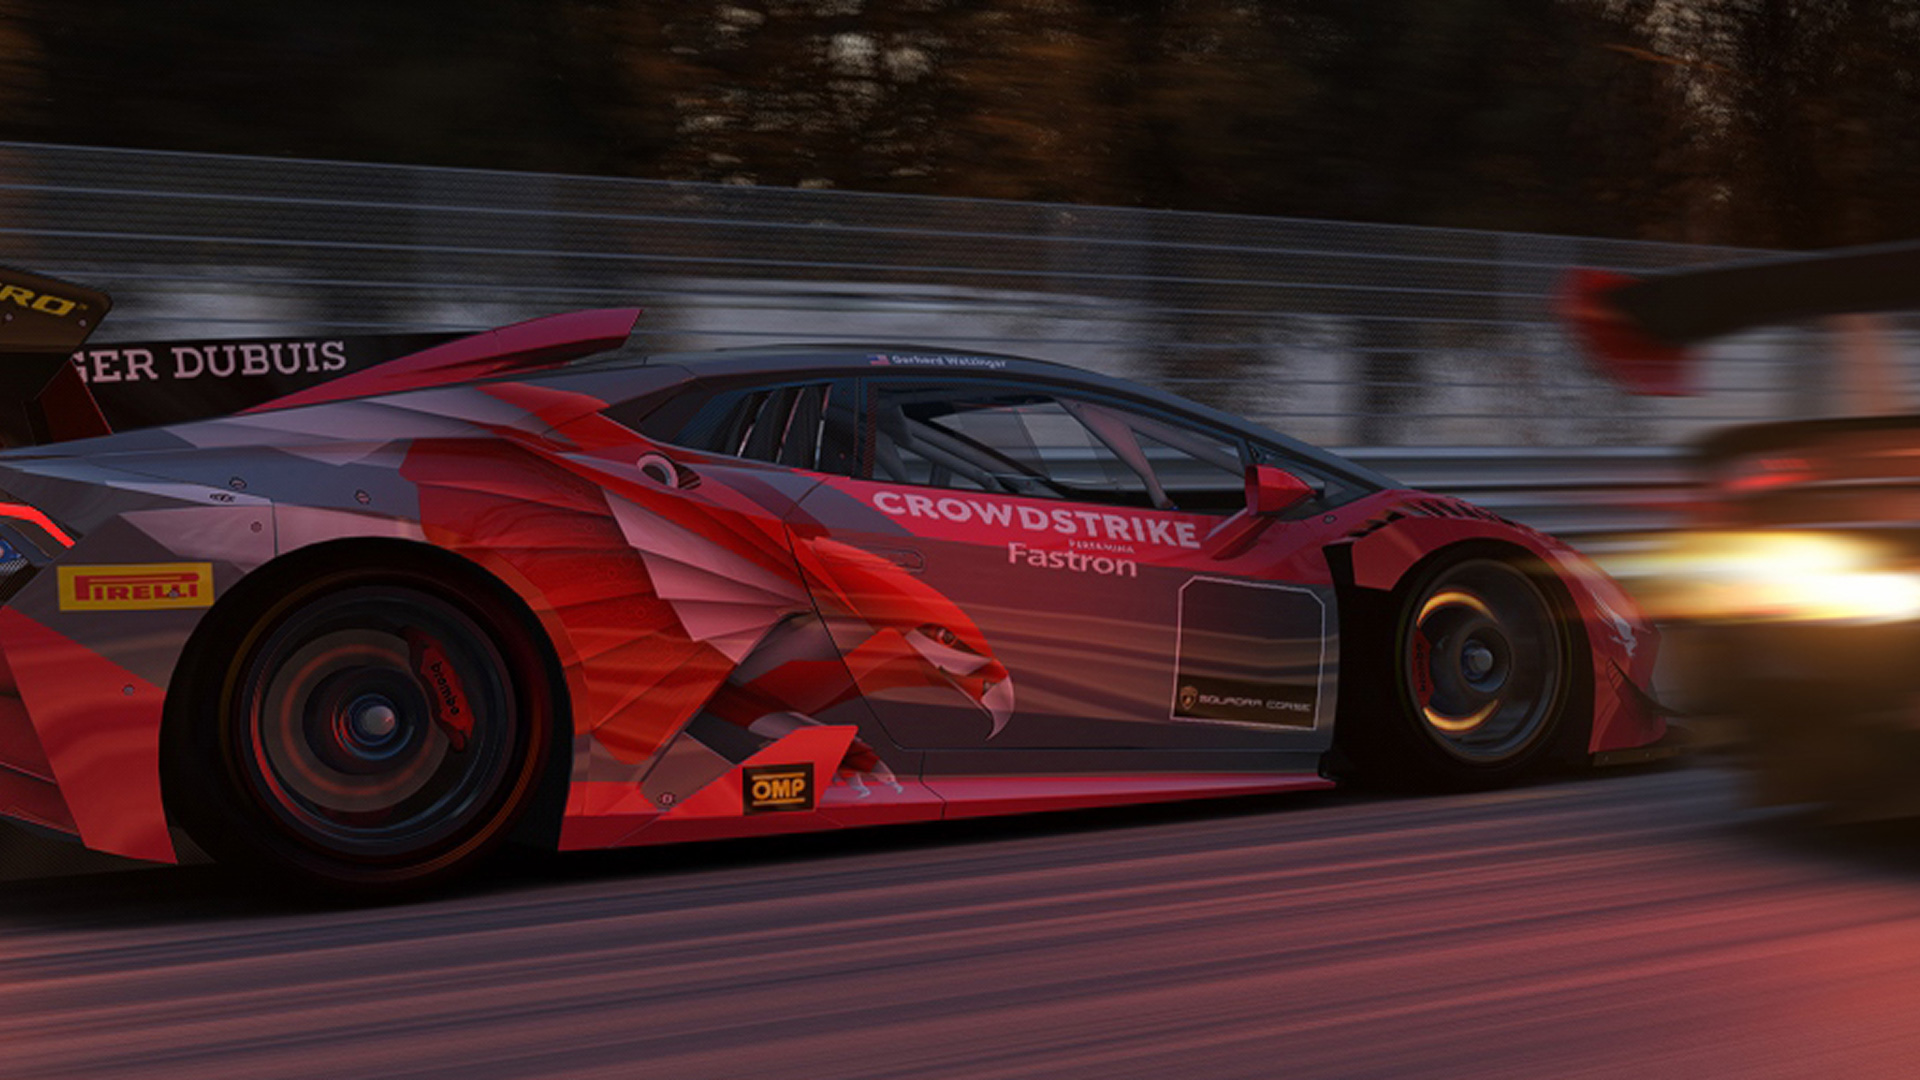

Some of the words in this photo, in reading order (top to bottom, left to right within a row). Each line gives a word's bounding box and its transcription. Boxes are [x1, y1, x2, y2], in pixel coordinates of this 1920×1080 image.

[0, 283, 77, 317] RO
[171, 341, 347, 380] DUBUIS
[891, 354, 944, 366] Gerhard
[873, 491, 1201, 548] CROWDSTRIKE
[1008, 542, 1137, 577] Fastron
[74, 572, 200, 602] PIRELLI
[1198, 694, 1263, 707] SQUADRA
[1266, 699, 1312, 712] CORSE
[752, 779, 805, 800] OMP
